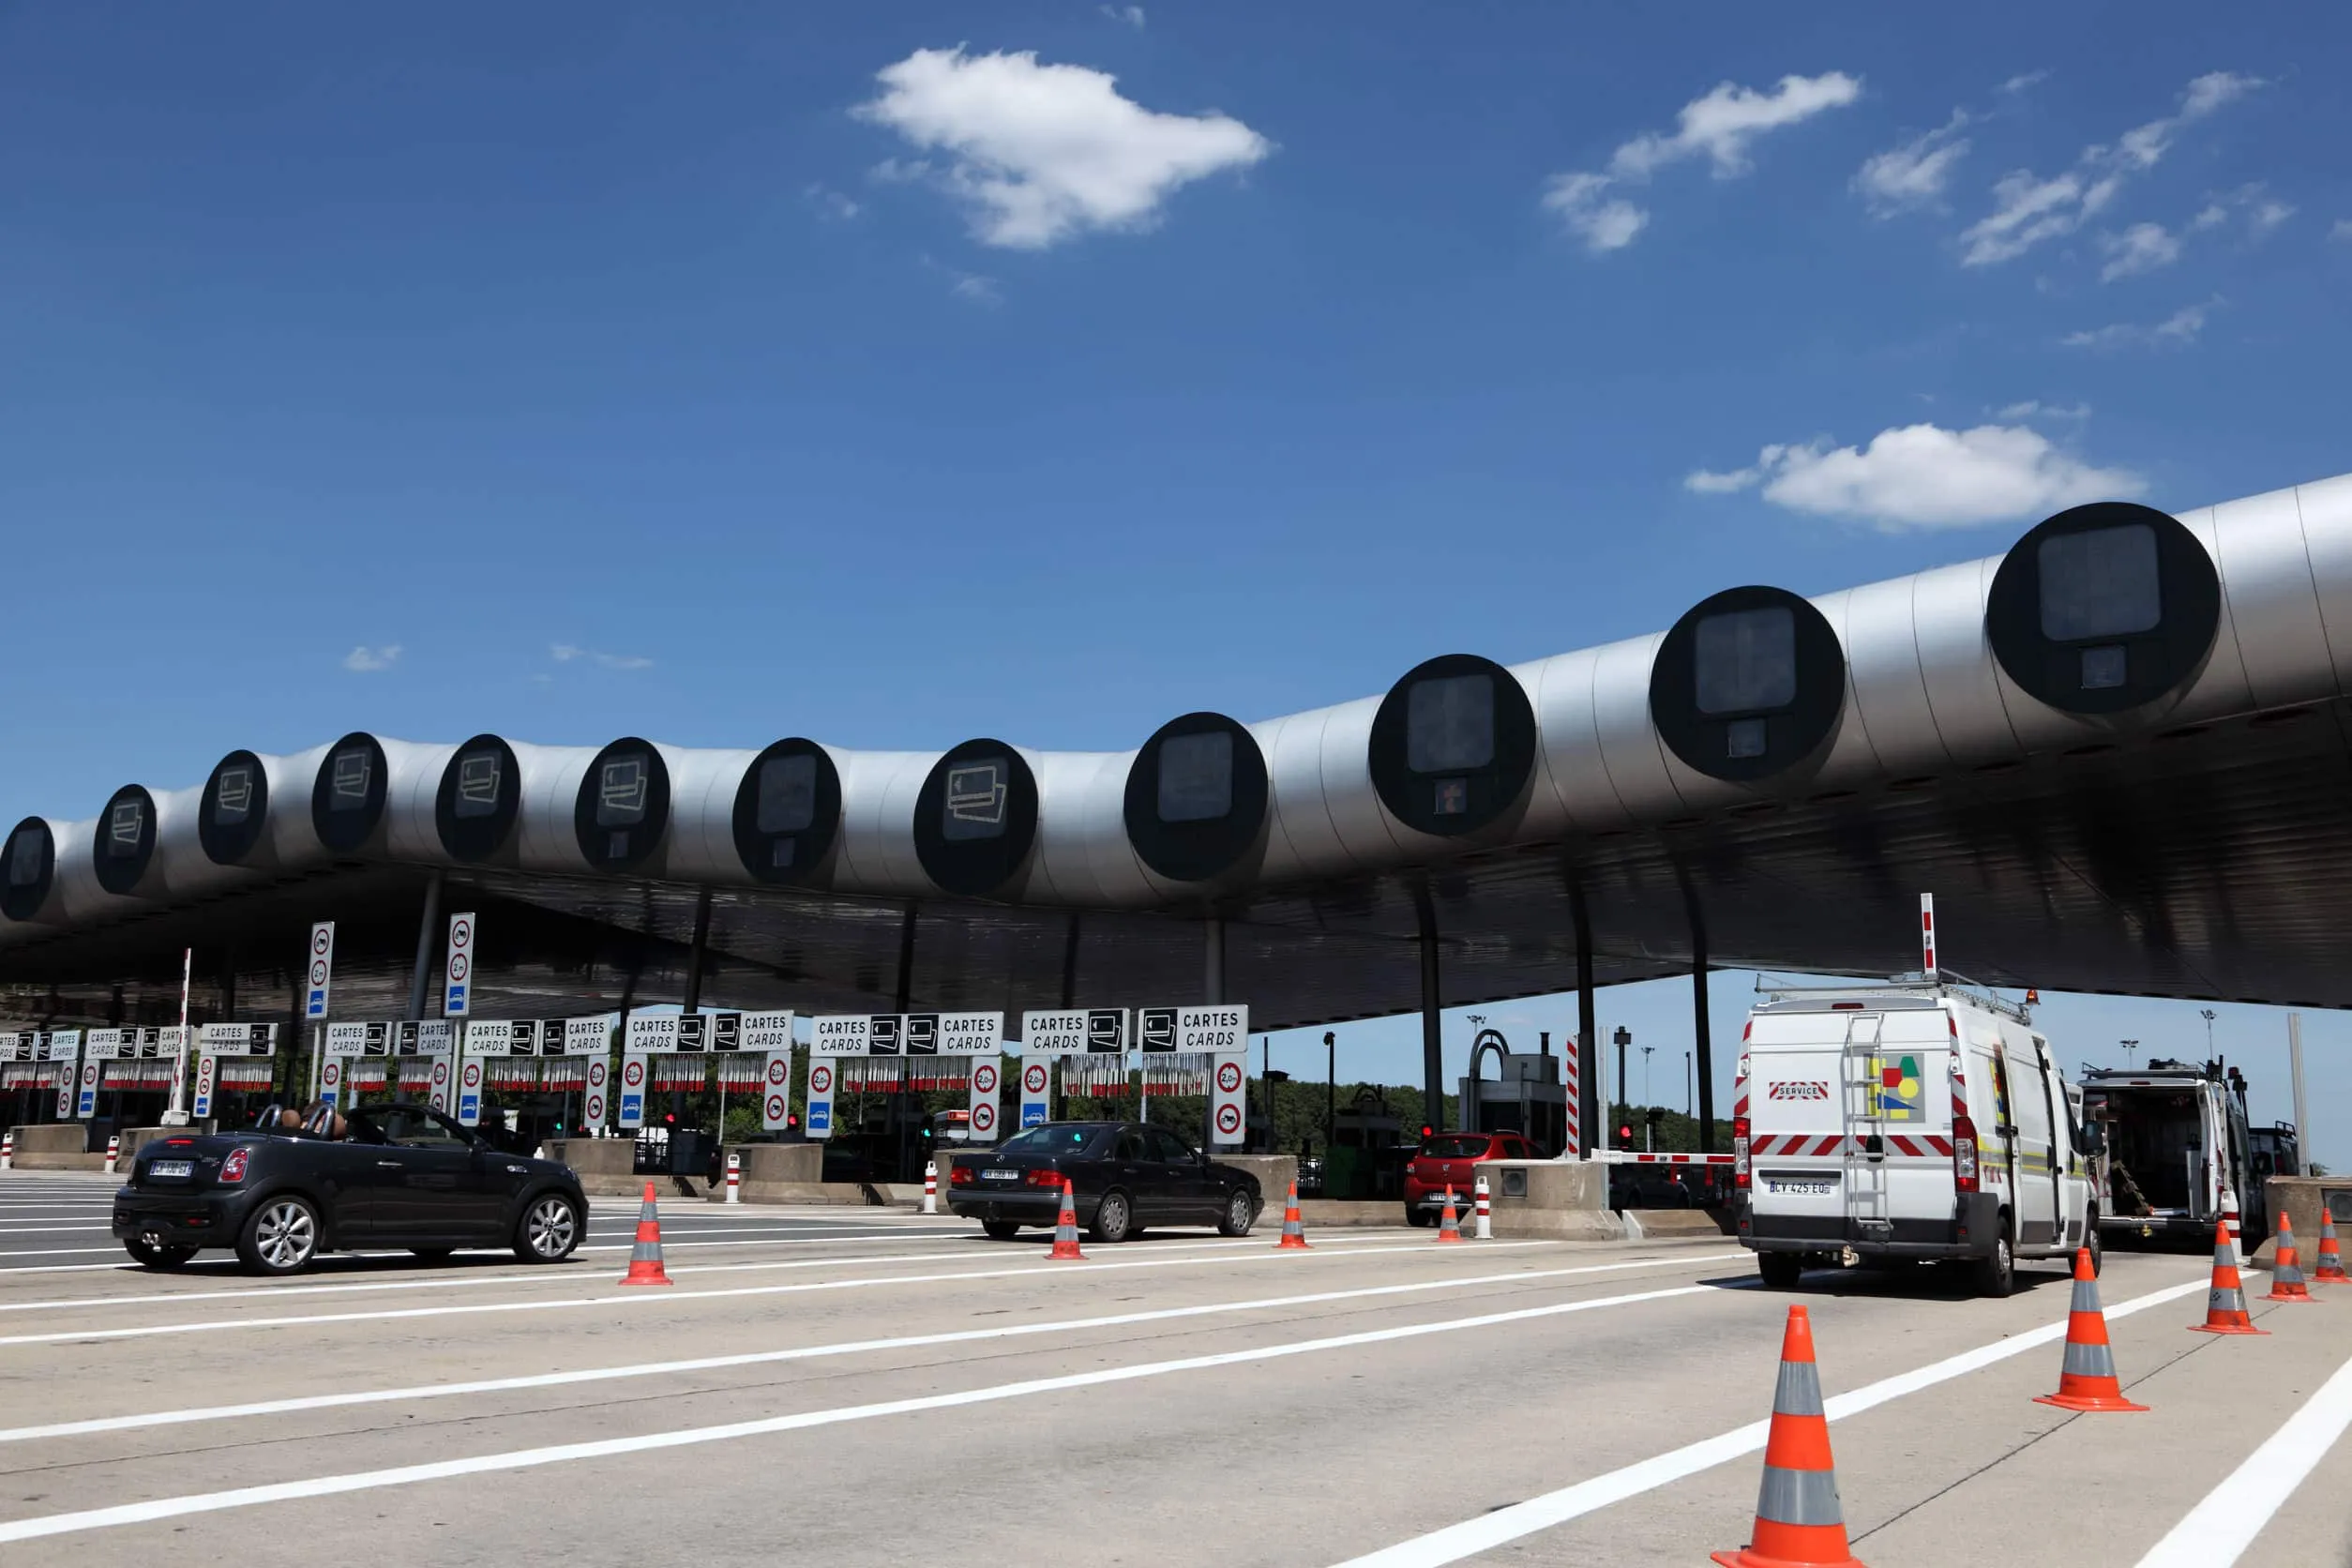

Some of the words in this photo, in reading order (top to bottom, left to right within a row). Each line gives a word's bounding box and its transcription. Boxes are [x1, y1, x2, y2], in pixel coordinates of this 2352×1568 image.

[745, 1017, 786, 1029] CARTES
[944, 1018, 995, 1032] CARTES
[1031, 1017, 1083, 1031] CARTES
[1184, 1013, 1238, 1027] CARTES
[331, 1027, 364, 1038] CARTES
[421, 1024, 449, 1035] CARTES
[471, 1026, 508, 1036] CARTES
[568, 1022, 605, 1034] CARTES
[633, 1020, 675, 1033] CARTES
[819, 1021, 866, 1034] CARTES
[54, 1034, 75, 1044] CARTES
[91, 1033, 118, 1042] CARTES
[211, 1028, 243, 1038] CARTES
[1186, 1032, 1235, 1046] CARDS
[212, 1040, 241, 1050] CARDS
[421, 1039, 447, 1050] CARDS
[472, 1040, 505, 1051] CARDS
[570, 1037, 601, 1049] CARDS
[634, 1036, 671, 1048] CARDS
[746, 1033, 784, 1046] CARDS
[821, 1038, 863, 1051] CARDS
[947, 1036, 991, 1049] CARDS
[1033, 1035, 1080, 1048] CARDS
[91, 1046, 114, 1055] CARDS
[332, 1041, 361, 1051] CARDS
